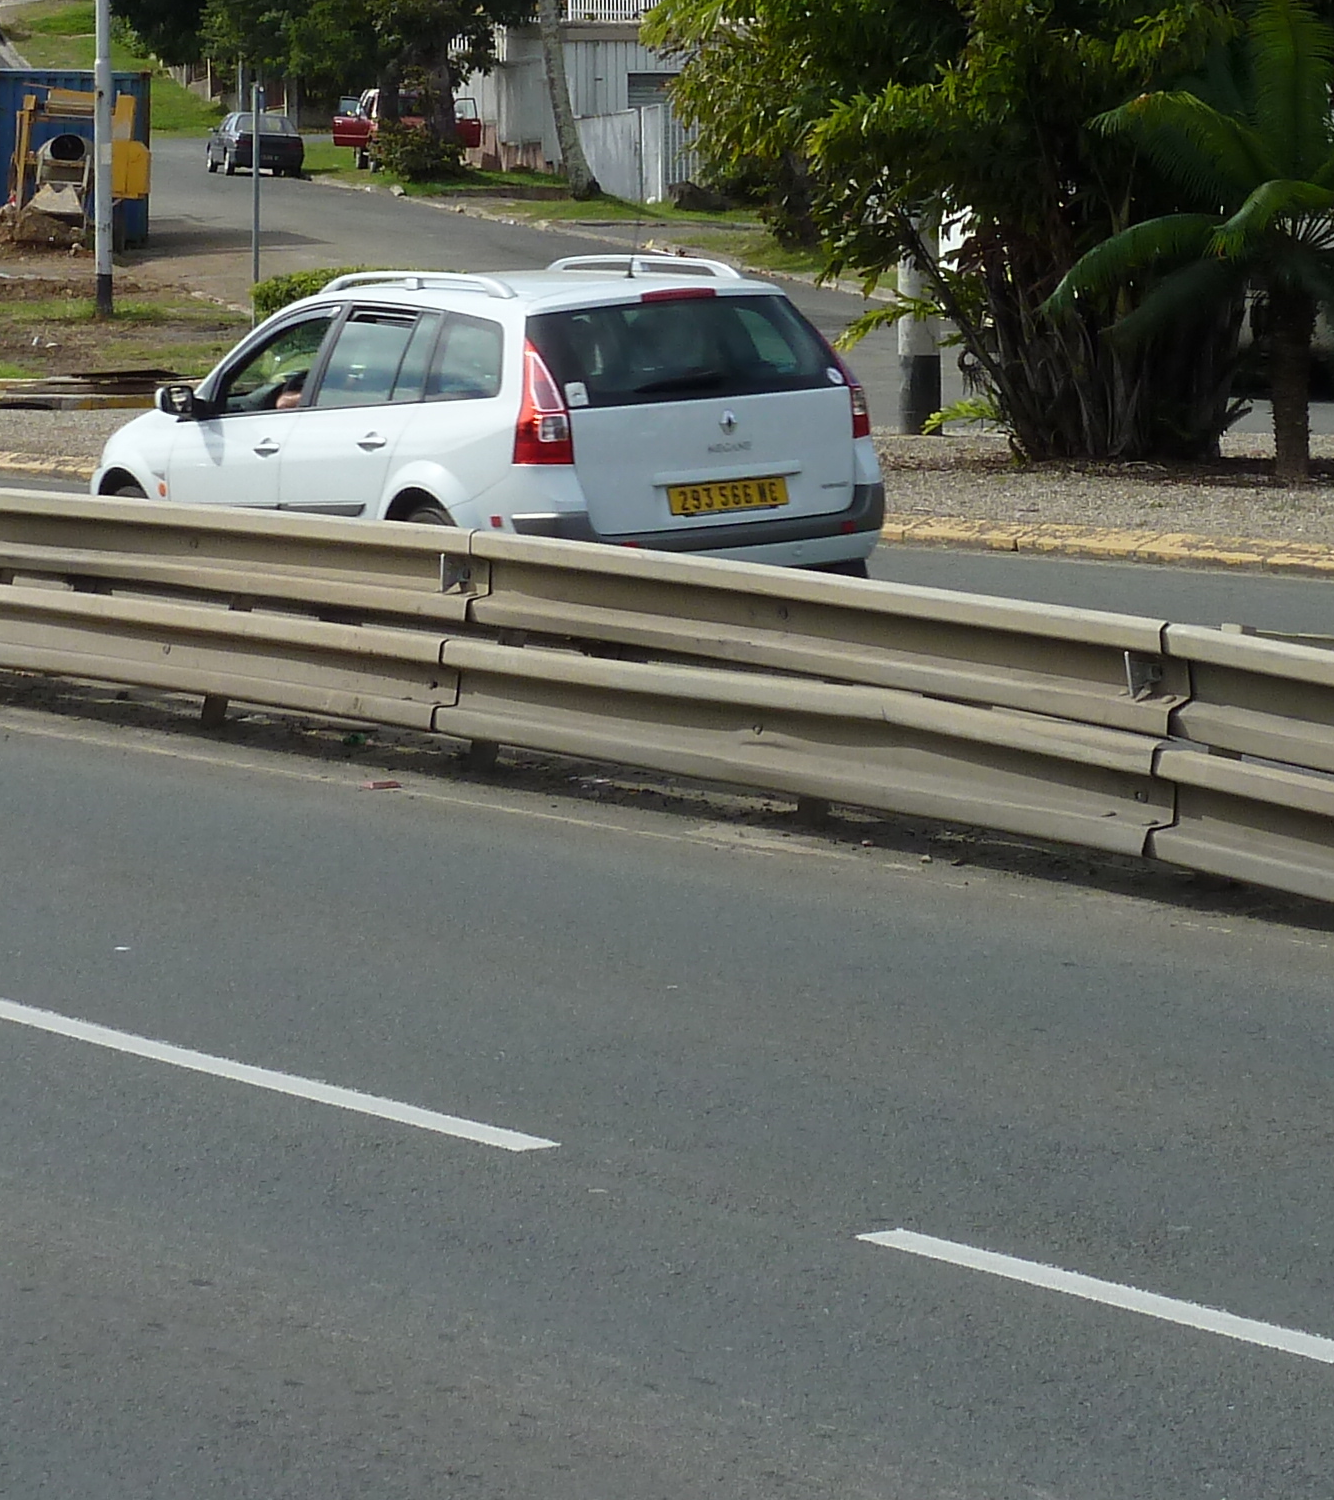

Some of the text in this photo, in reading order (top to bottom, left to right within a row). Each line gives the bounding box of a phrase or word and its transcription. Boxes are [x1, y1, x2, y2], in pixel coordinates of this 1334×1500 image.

[678, 482, 779, 511] 293 566 NC
